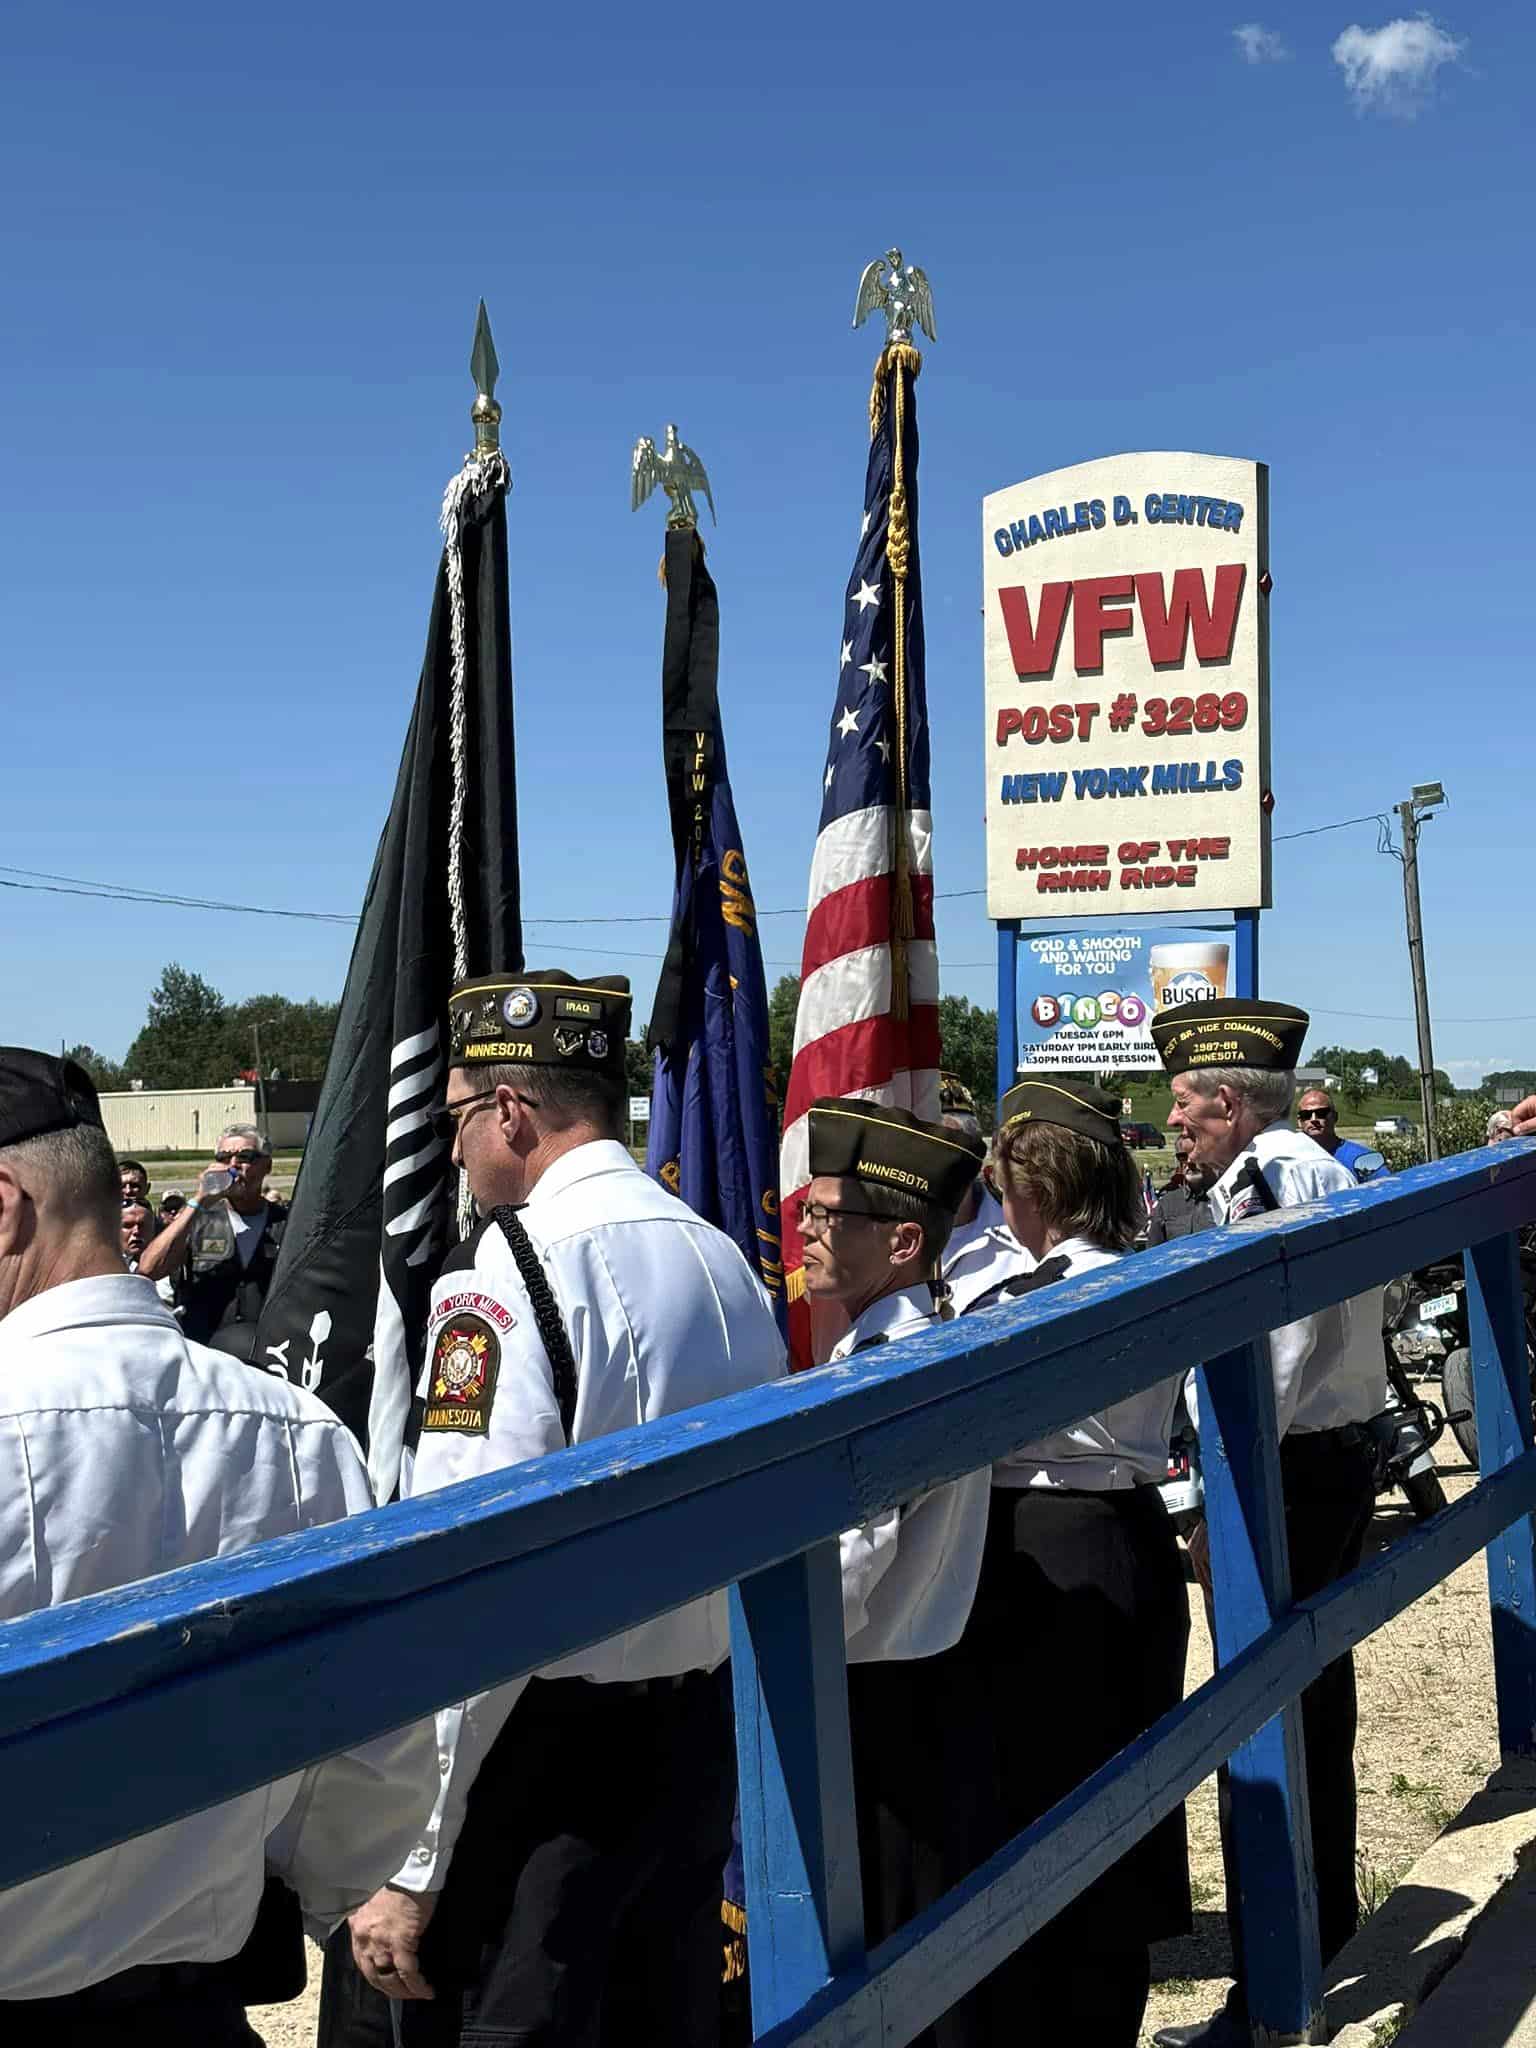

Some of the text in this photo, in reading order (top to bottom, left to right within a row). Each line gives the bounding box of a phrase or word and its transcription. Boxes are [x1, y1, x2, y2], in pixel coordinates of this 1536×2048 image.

[993, 493, 1244, 557] CHARLES D. CENTER
[998, 563, 1246, 683] VFW
[996, 692, 1248, 747] POST #3289
[1001, 759, 1244, 805] NEW YORK MILLS
[1016, 837, 1231, 870] HOME OF THE
[1120, 865, 1198, 889] RIDE
[1031, 936, 1142, 952] COLD & SMOOTH
[1040, 949, 1132, 964] AND WAITING
[1055, 962, 1115, 975] FOR YOU
[1162, 986, 1217, 1005] BUSCH
[565, 1002, 591, 1013] IRAQ
[1036, 995, 1140, 1022] BINGO
[1055, 1030, 1124, 1040] TUESDAY 6PM
[1197, 1022, 1221, 1033] VICE
[1223, 1022, 1284, 1051] COMMANDER
[464, 1043, 533, 1059] MINNESOTA
[1023, 1042, 1157, 1053] SATURDAY 1PM EARLY BIRD
[1061, 1055, 1110, 1064] REGULAR
[1112, 1054, 1156, 1063] SESSION
[1189, 1051, 1245, 1064] MINNESOTA
[857, 1159, 929, 1191] MINNESOTA
[449, 1293, 511, 1325] YORK MILLS
[426, 1408, 482, 1427] MINNESOTA
